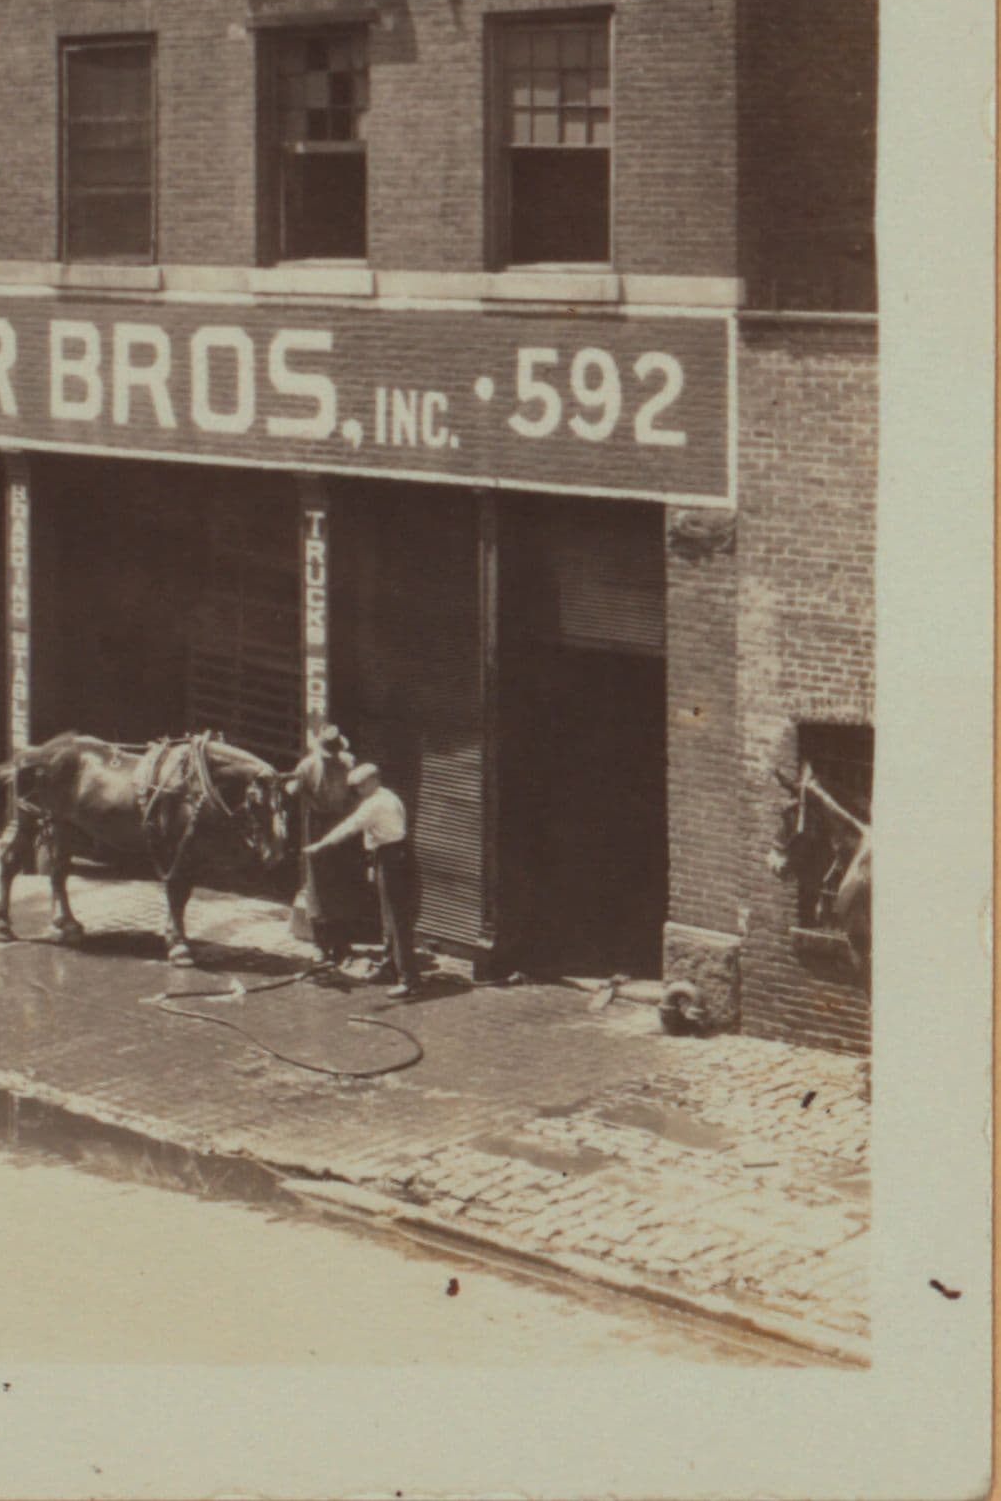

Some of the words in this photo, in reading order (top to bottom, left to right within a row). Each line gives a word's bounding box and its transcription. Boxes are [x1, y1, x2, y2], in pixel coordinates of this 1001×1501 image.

[375, 387, 461, 449] INC.
[508, 346, 689, 448] 592
[305, 510, 326, 646] TRUCKS
[306, 657, 327, 716] FOR
